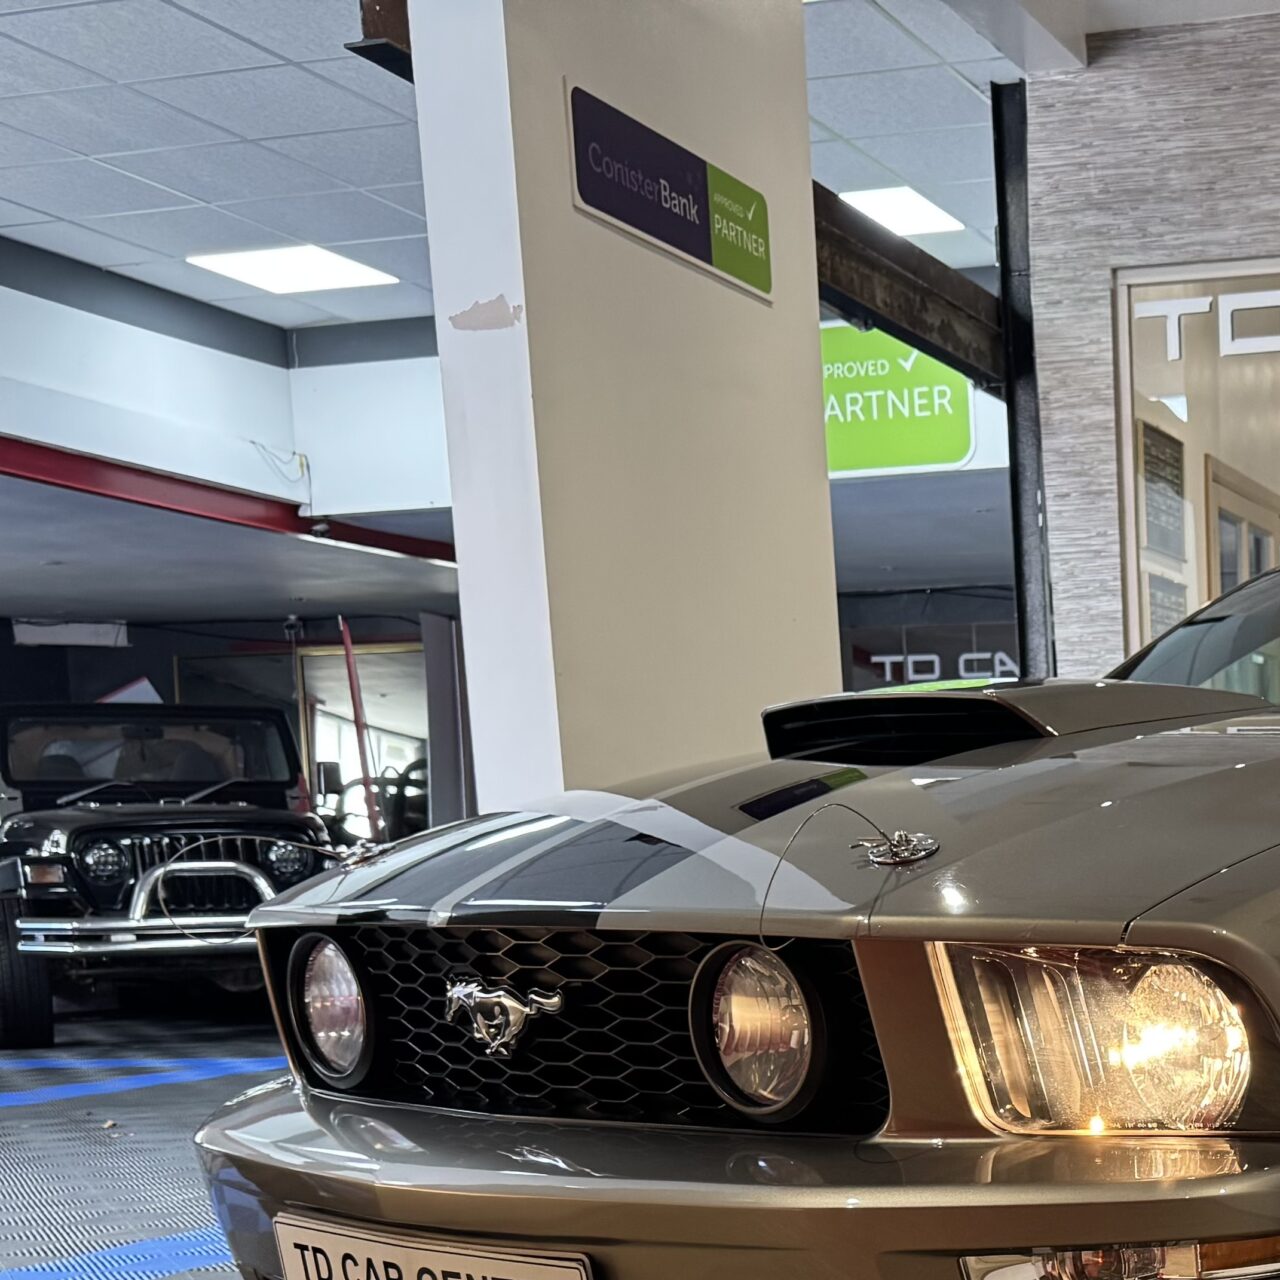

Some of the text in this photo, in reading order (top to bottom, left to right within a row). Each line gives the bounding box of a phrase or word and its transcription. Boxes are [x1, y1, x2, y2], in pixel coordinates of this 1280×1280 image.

[587, 142, 699, 224] ConisterBank
[714, 214, 766, 260] PARTNER
[824, 358, 890, 379] PROVED
[824, 384, 953, 423] ARTNER
[870, 654, 940, 682] TD
